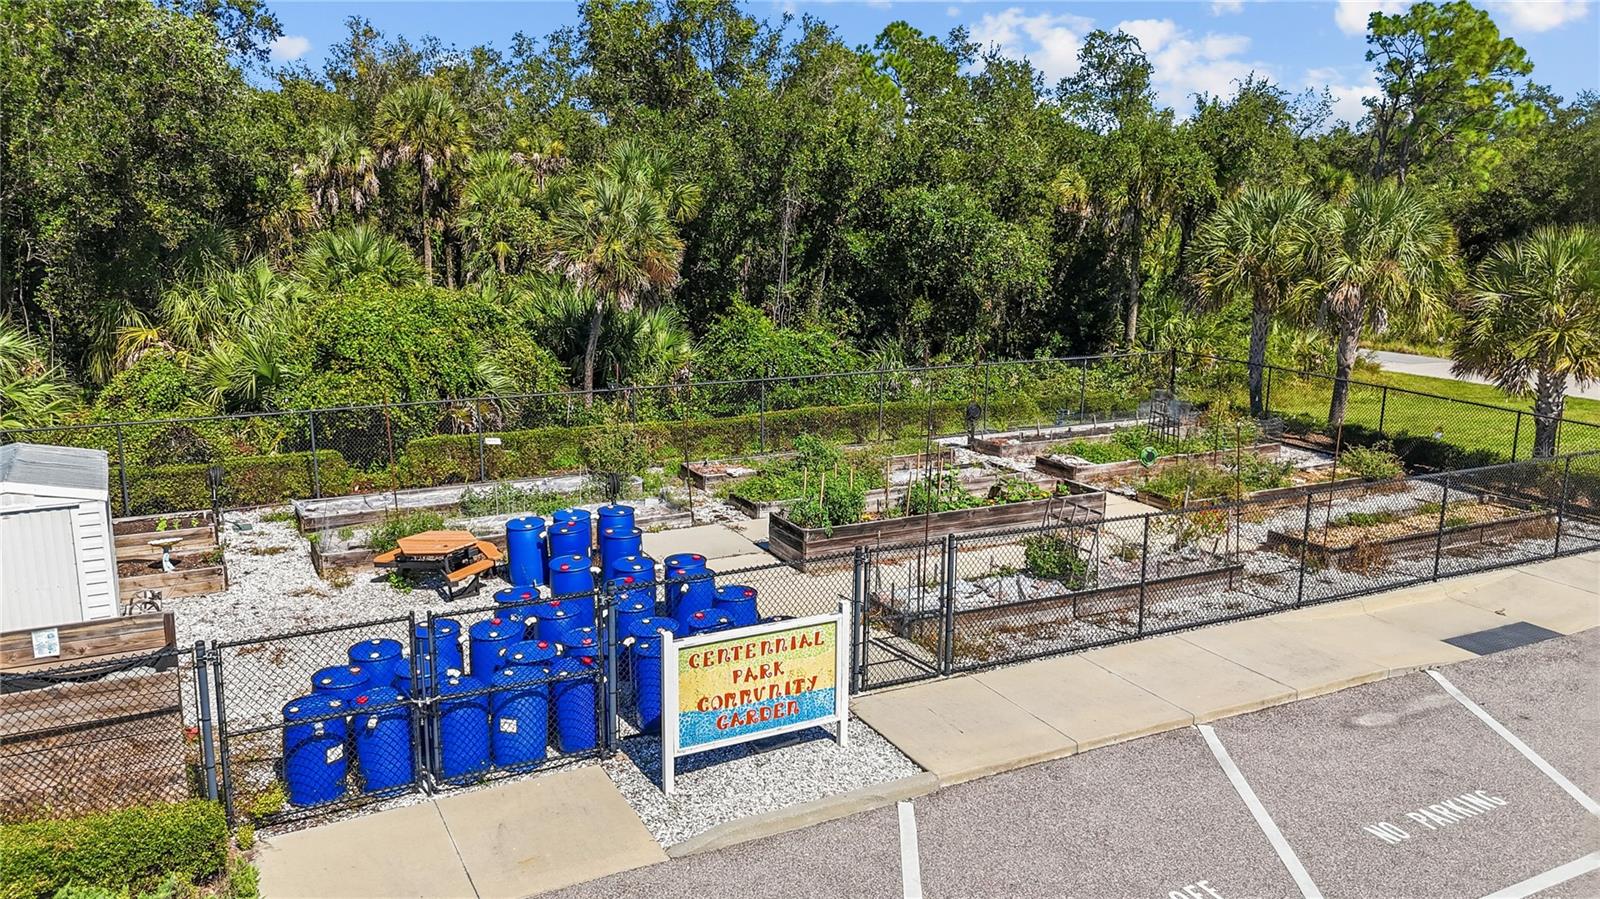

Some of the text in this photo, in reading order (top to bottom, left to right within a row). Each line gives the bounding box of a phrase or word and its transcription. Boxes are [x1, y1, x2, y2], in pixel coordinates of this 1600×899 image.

[688, 631, 825, 669] CENTENNIAL
[732, 661, 785, 684] PARK
[696, 675, 818, 713] COMMUNITY
[716, 701, 800, 730] GARDEN
[1362, 789, 1508, 844] NO PARKING
